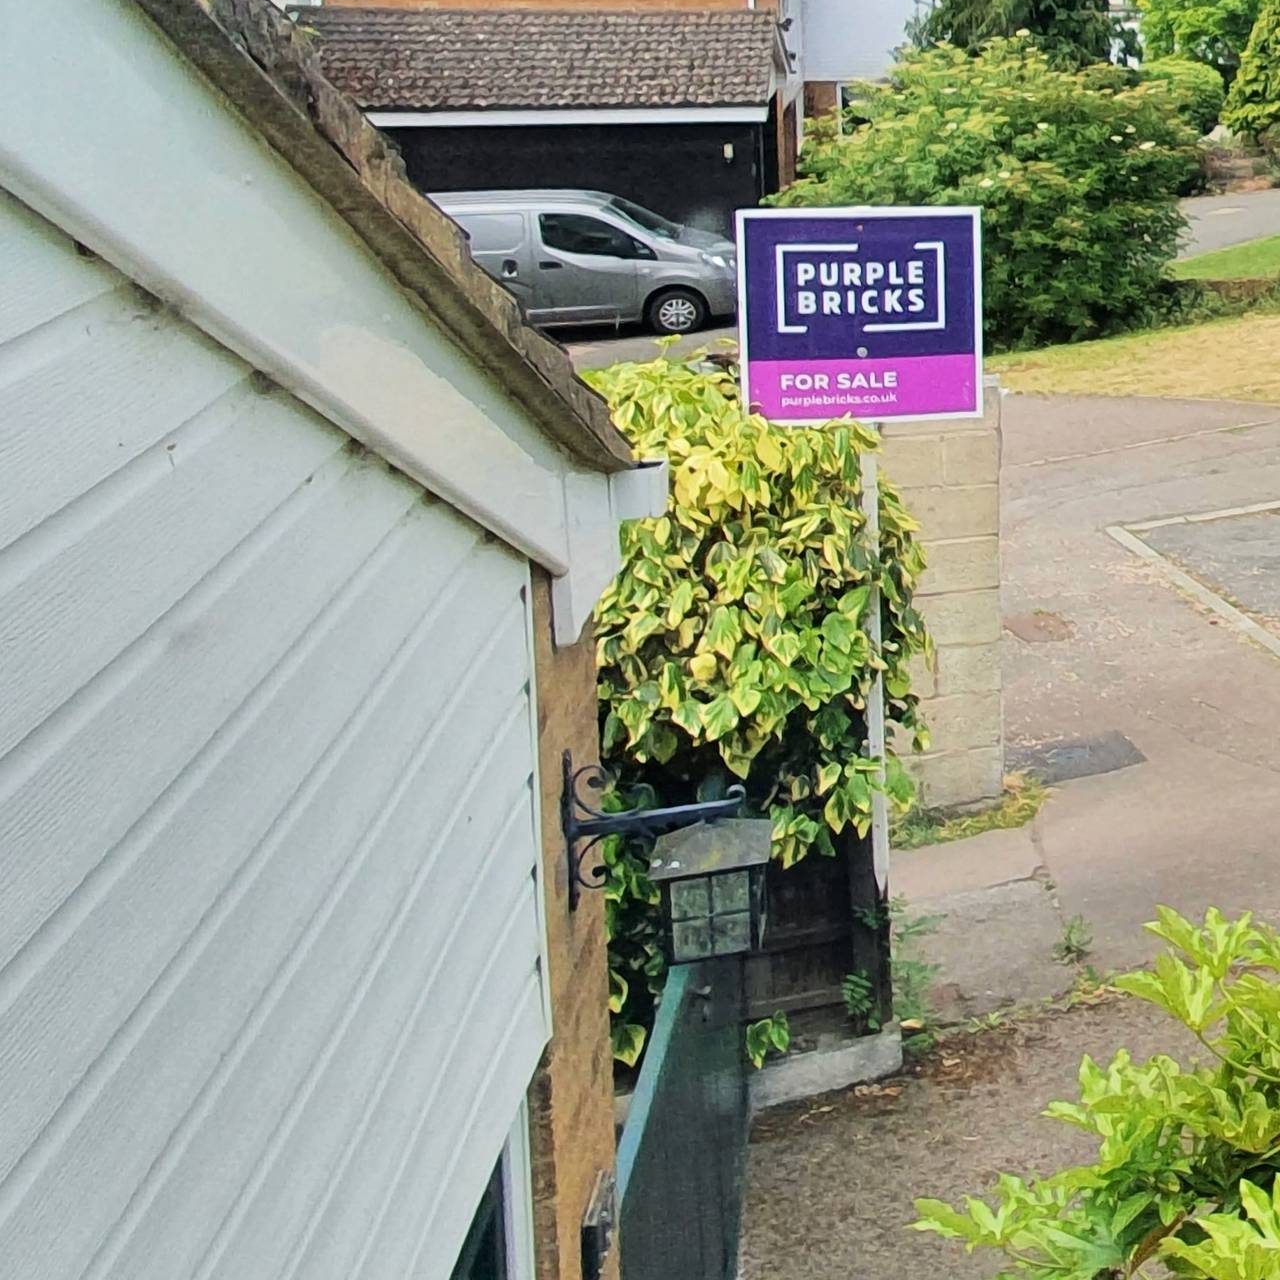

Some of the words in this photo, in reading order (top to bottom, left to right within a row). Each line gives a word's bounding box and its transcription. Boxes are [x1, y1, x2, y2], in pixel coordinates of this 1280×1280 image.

[796, 260, 925, 287] PURPLE
[797, 288, 926, 315] BRICKS
[780, 373, 829, 391] FOR
[837, 371, 898, 389] SALE
[781, 391, 897, 408] purplebricks.co.uk
